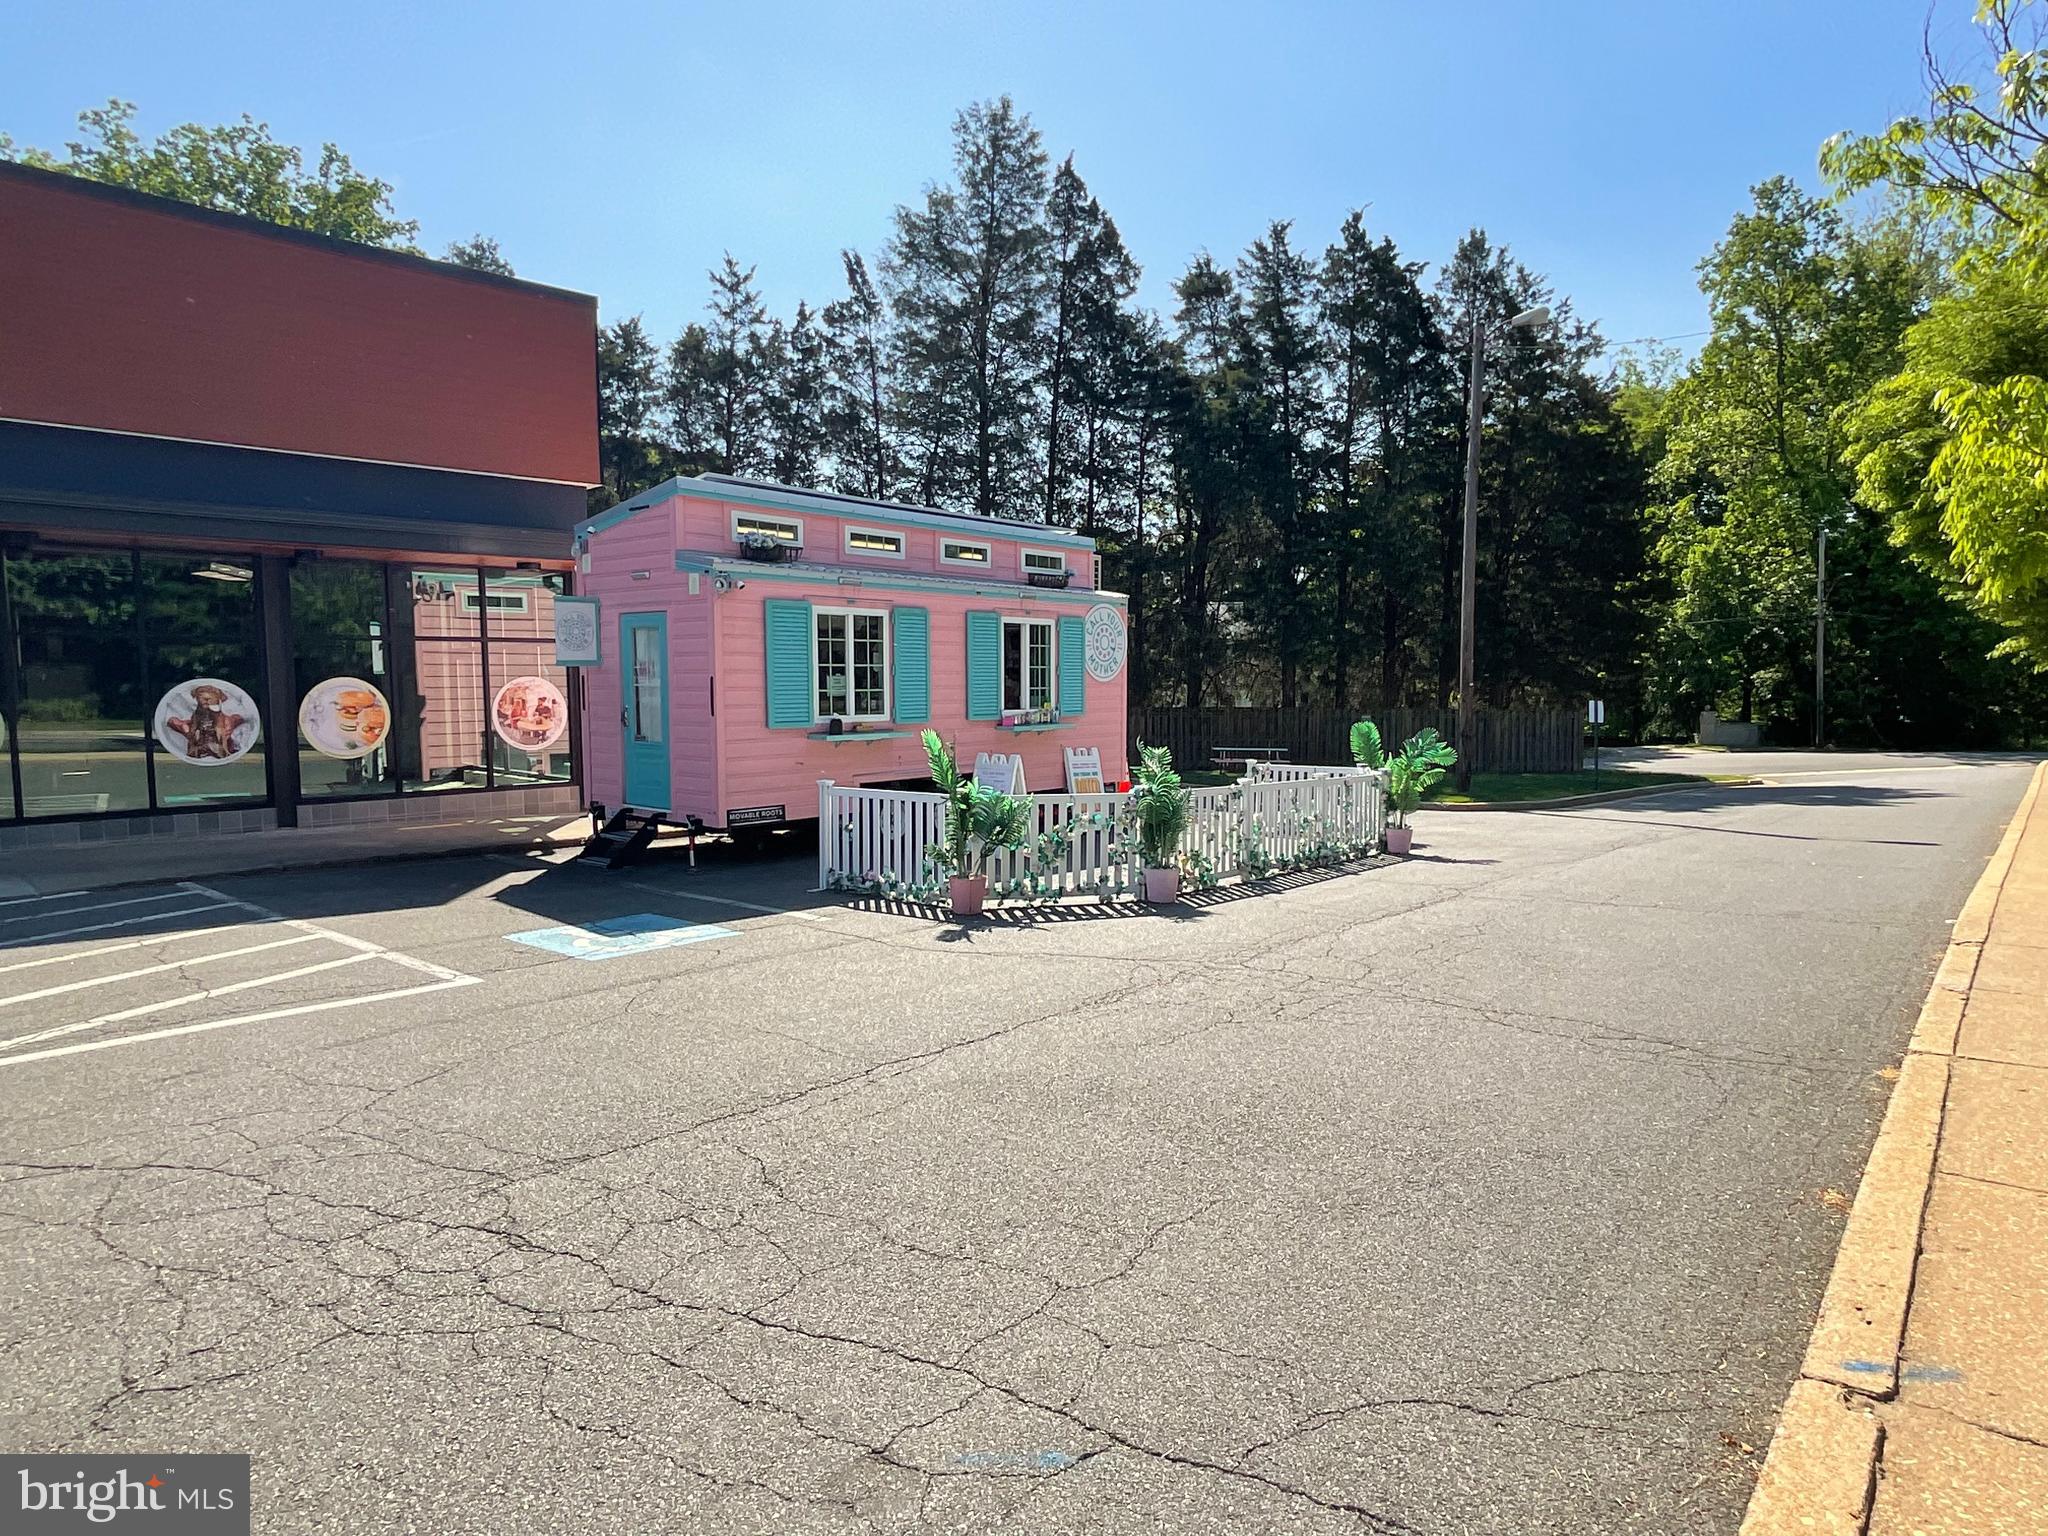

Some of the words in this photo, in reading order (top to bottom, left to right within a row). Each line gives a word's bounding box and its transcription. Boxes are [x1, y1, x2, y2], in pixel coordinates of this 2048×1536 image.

[1086, 613, 1104, 636] CALL
[1107, 612, 1123, 637] YOUR
[1088, 655, 1119, 675] MOTHER
[729, 811, 760, 820] MOVABLE
[761, 809, 783, 817] ROOTS
